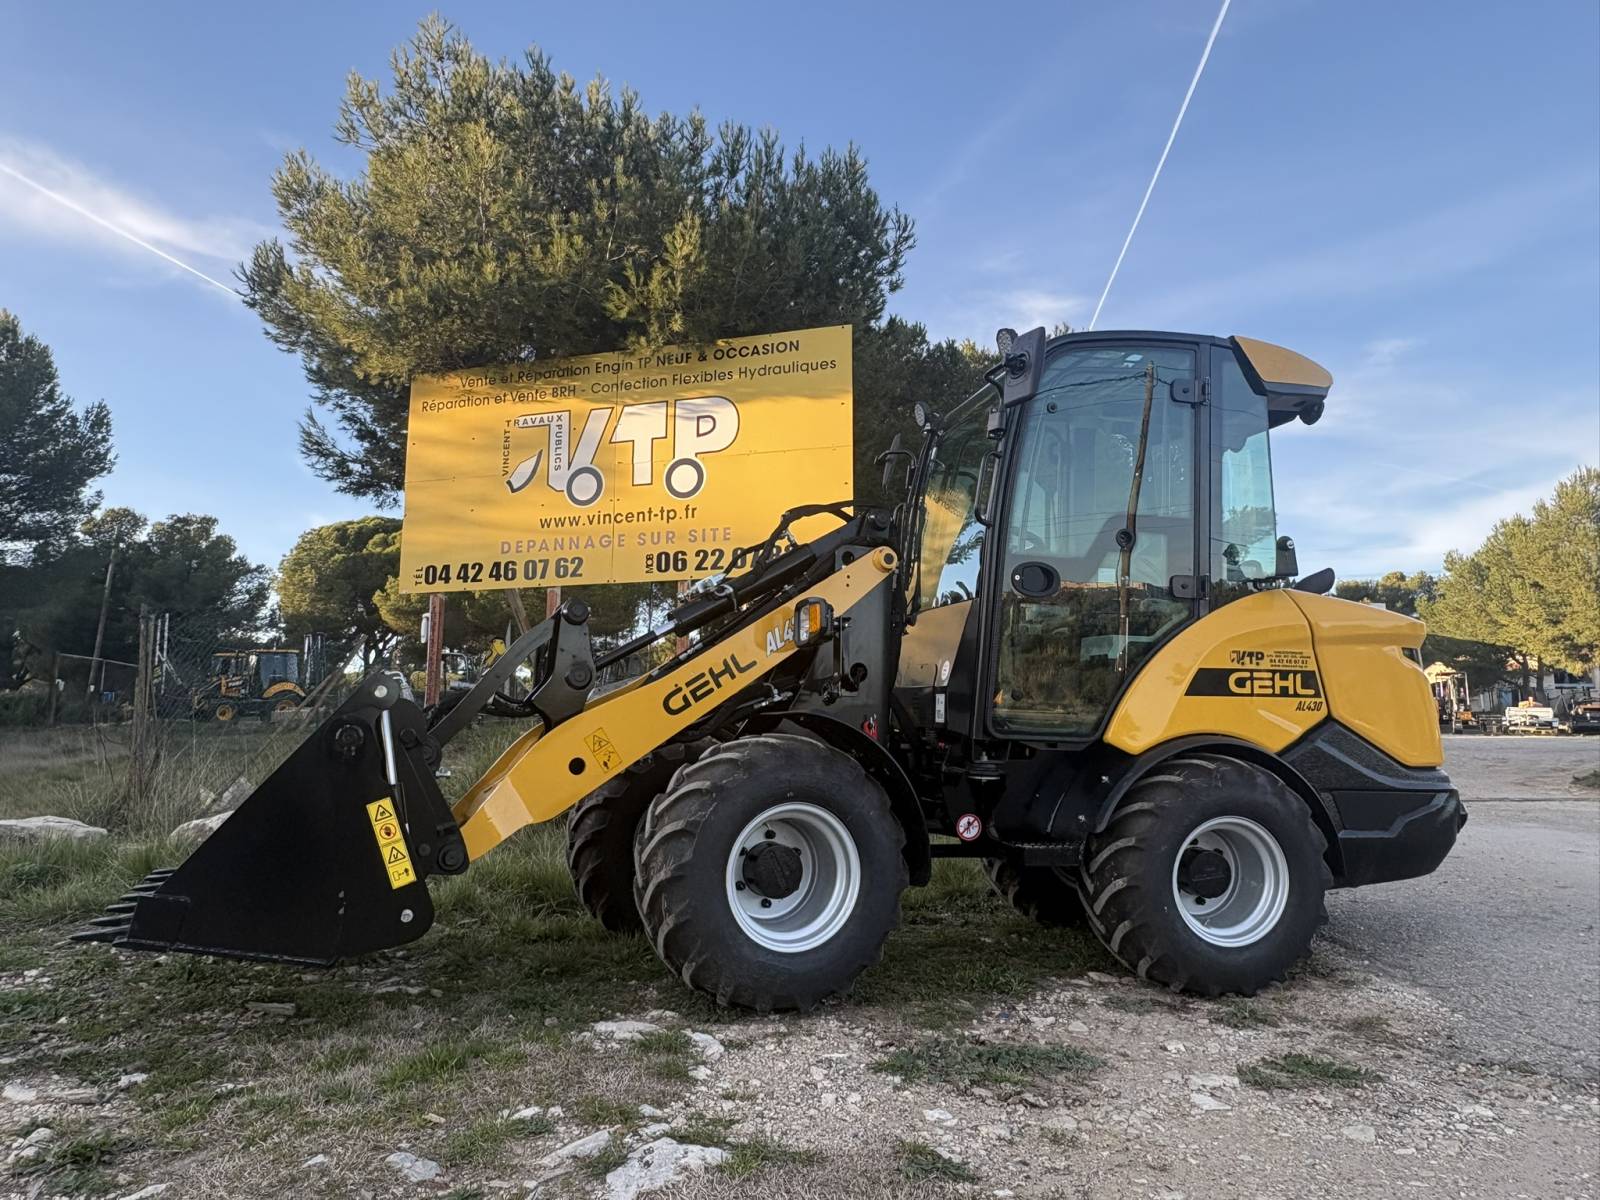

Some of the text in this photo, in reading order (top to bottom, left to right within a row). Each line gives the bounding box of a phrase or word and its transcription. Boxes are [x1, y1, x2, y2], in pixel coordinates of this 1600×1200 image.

[460, 340, 800, 388] Vente et Réparation Engin TP NEUF & OCCASION
[421, 395, 490, 413] Réparation
[494, 392, 507, 404] et
[510, 389, 547, 403] Vente
[551, 385, 576, 398] BRH
[591, 374, 667, 394] Confection
[672, 368, 734, 386] Flexibles
[738, 358, 837, 380] Hydrauliques
[502, 414, 563, 476] VINCENT TRAVAUX PUBLICS
[540, 505, 697, 529] www.vincent-tp.fr
[501, 527, 732, 554] DEPANNAGE SUR SITE
[424, 564, 451, 585] 04
[456, 562, 484, 583] 42
[488, 560, 518, 581] 46
[523, 558, 550, 581] 07
[555, 556, 584, 579] 62
[656, 550, 687, 573] 06
[694, 548, 725, 571] 22
[766, 616, 795, 657] AL4
[663, 653, 757, 716] GEHL
[1228, 671, 1315, 695] GEHL
[1295, 701, 1323, 712] AL430
